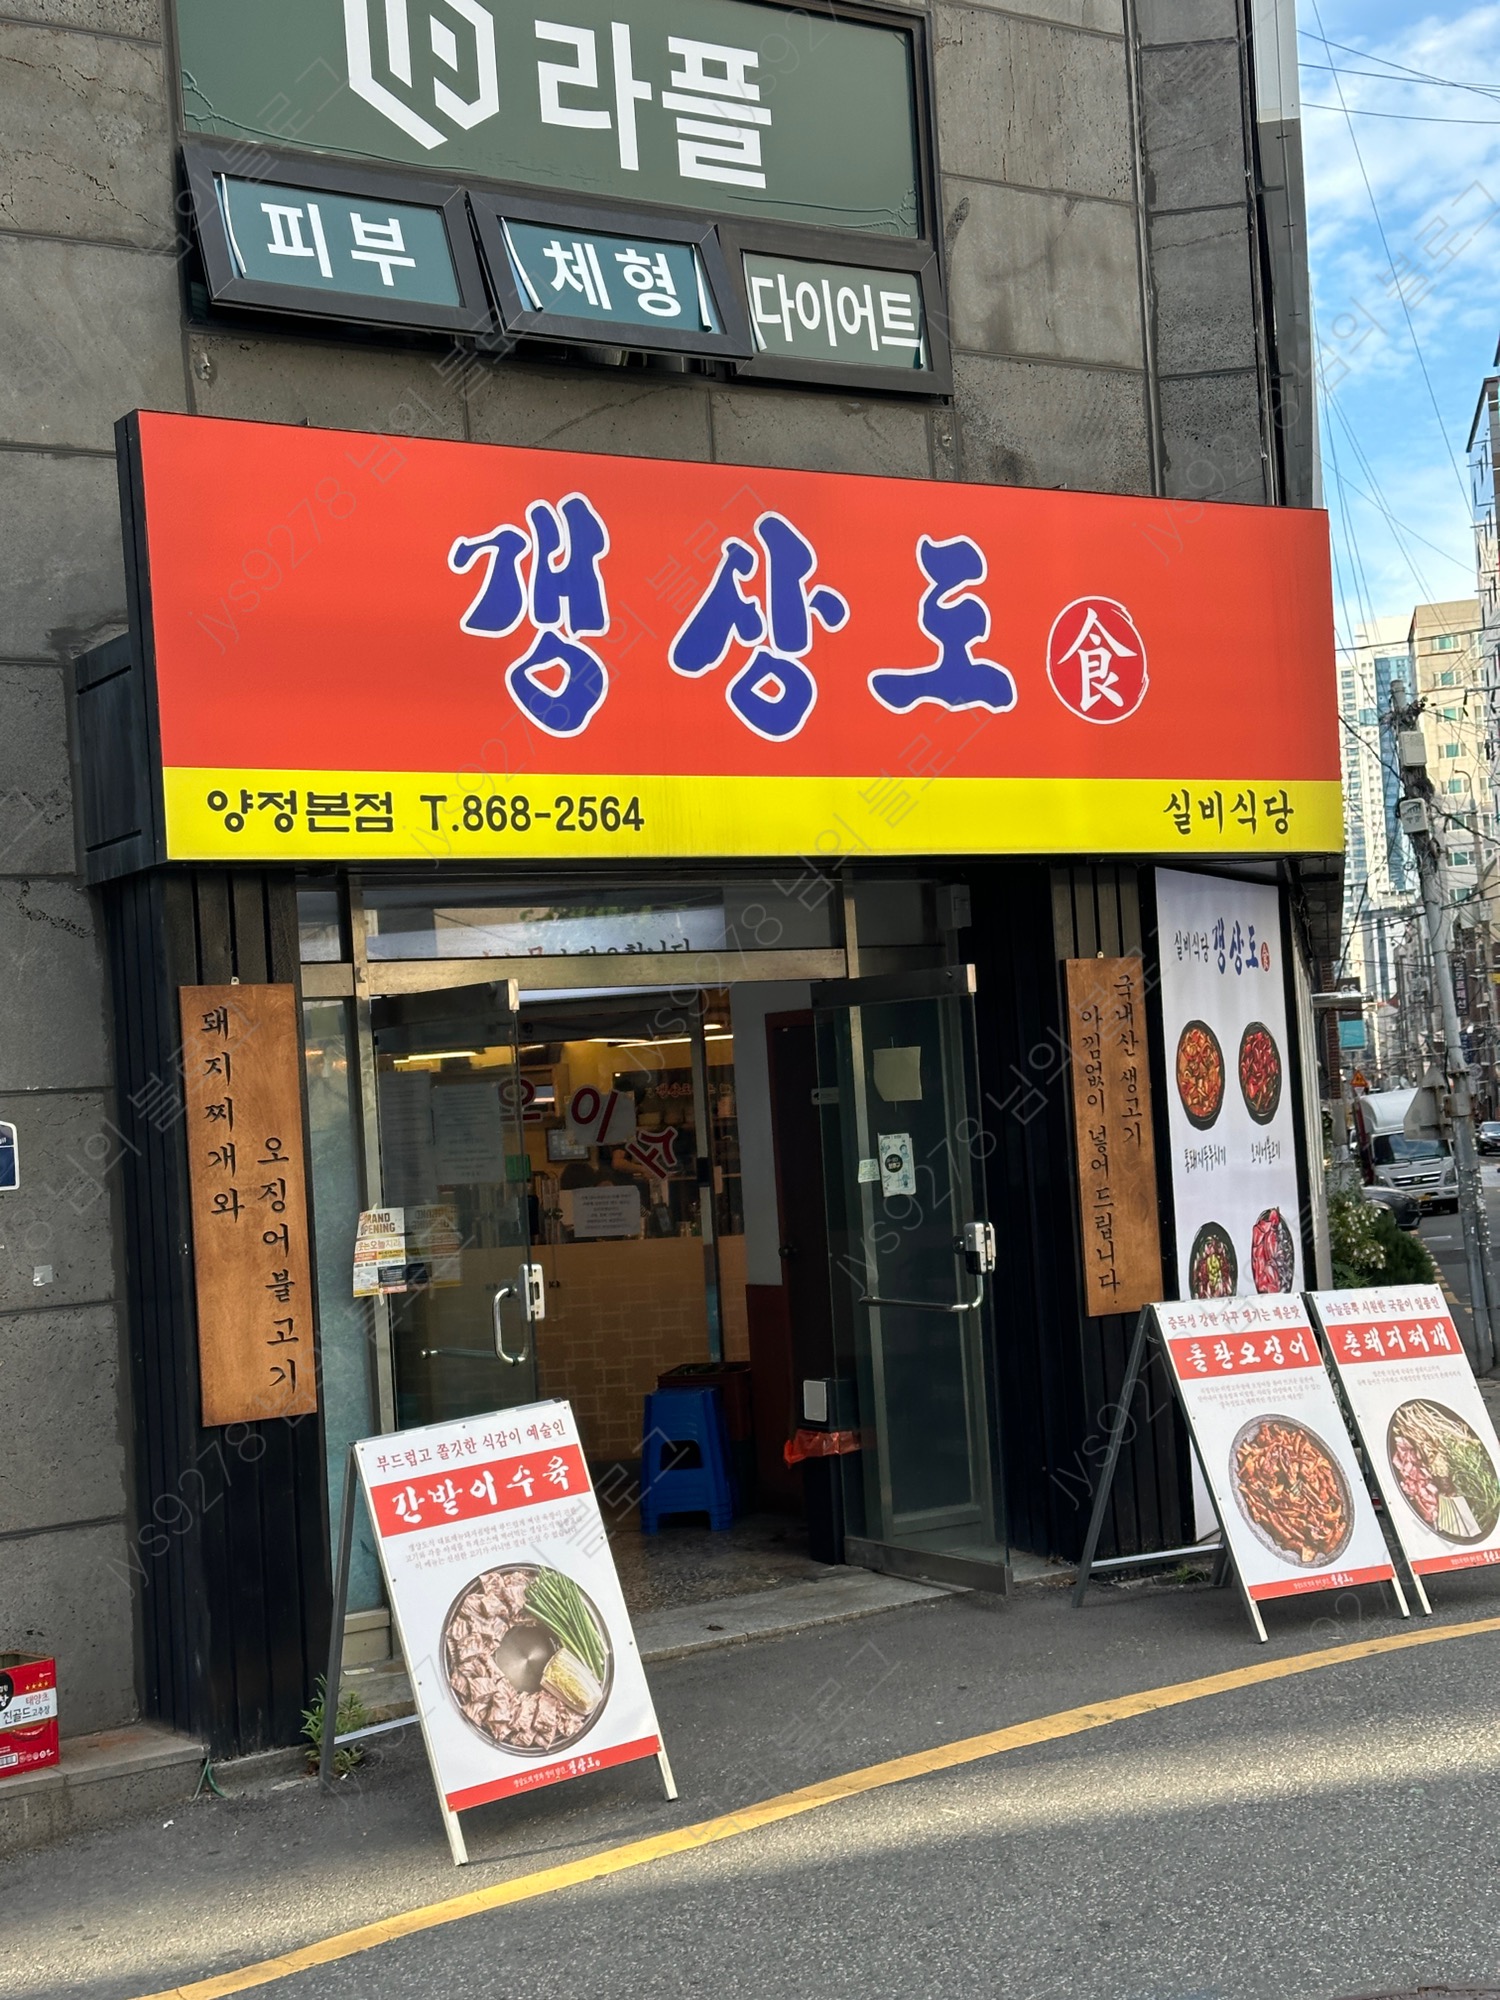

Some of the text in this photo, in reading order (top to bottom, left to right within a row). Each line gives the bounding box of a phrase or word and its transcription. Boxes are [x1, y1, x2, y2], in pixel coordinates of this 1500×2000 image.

[534, 19, 772, 189] 라플
[260, 202, 417, 287] 피부
[542, 239, 682, 318] 체형
[751, 274, 920, 351] 다이어트
[448, 492, 1138, 743] 갱상도 食
[207, 789, 1295, 837] 양정본점 T.868-2564 실비식당
[1174, 930, 1209, 963] 실비식당
[1212, 917, 1259, 976] 갱상도
[1081, 1004, 1105, 1117] 아낌없이
[1113, 974, 1143, 1151] 국내산 생고기
[200, 1006, 245, 1224] 돼지찌개와
[257, 1136, 299, 1395] 오징어불고기
[1168, 1315, 1197, 1331] 중독성
[1200, 1312, 1219, 1328] 강한
[1221, 1310, 1240, 1326] 자꾸
[1272, 1304, 1301, 1321] 매운맛
[1325, 1296, 1441, 1318] 마늘듬뿍 시원한 국물이 일품인
[1342, 1321, 1452, 1358] 촌돼지찌개
[1186, 1332, 1310, 1374] 돌판오징어
[376, 1418, 567, 1473] 부드럽고 쫄깃한 식감이 예술인
[25, 1692, 51, 1706] 태양초
[32, 1704, 51, 1718] 고추장
